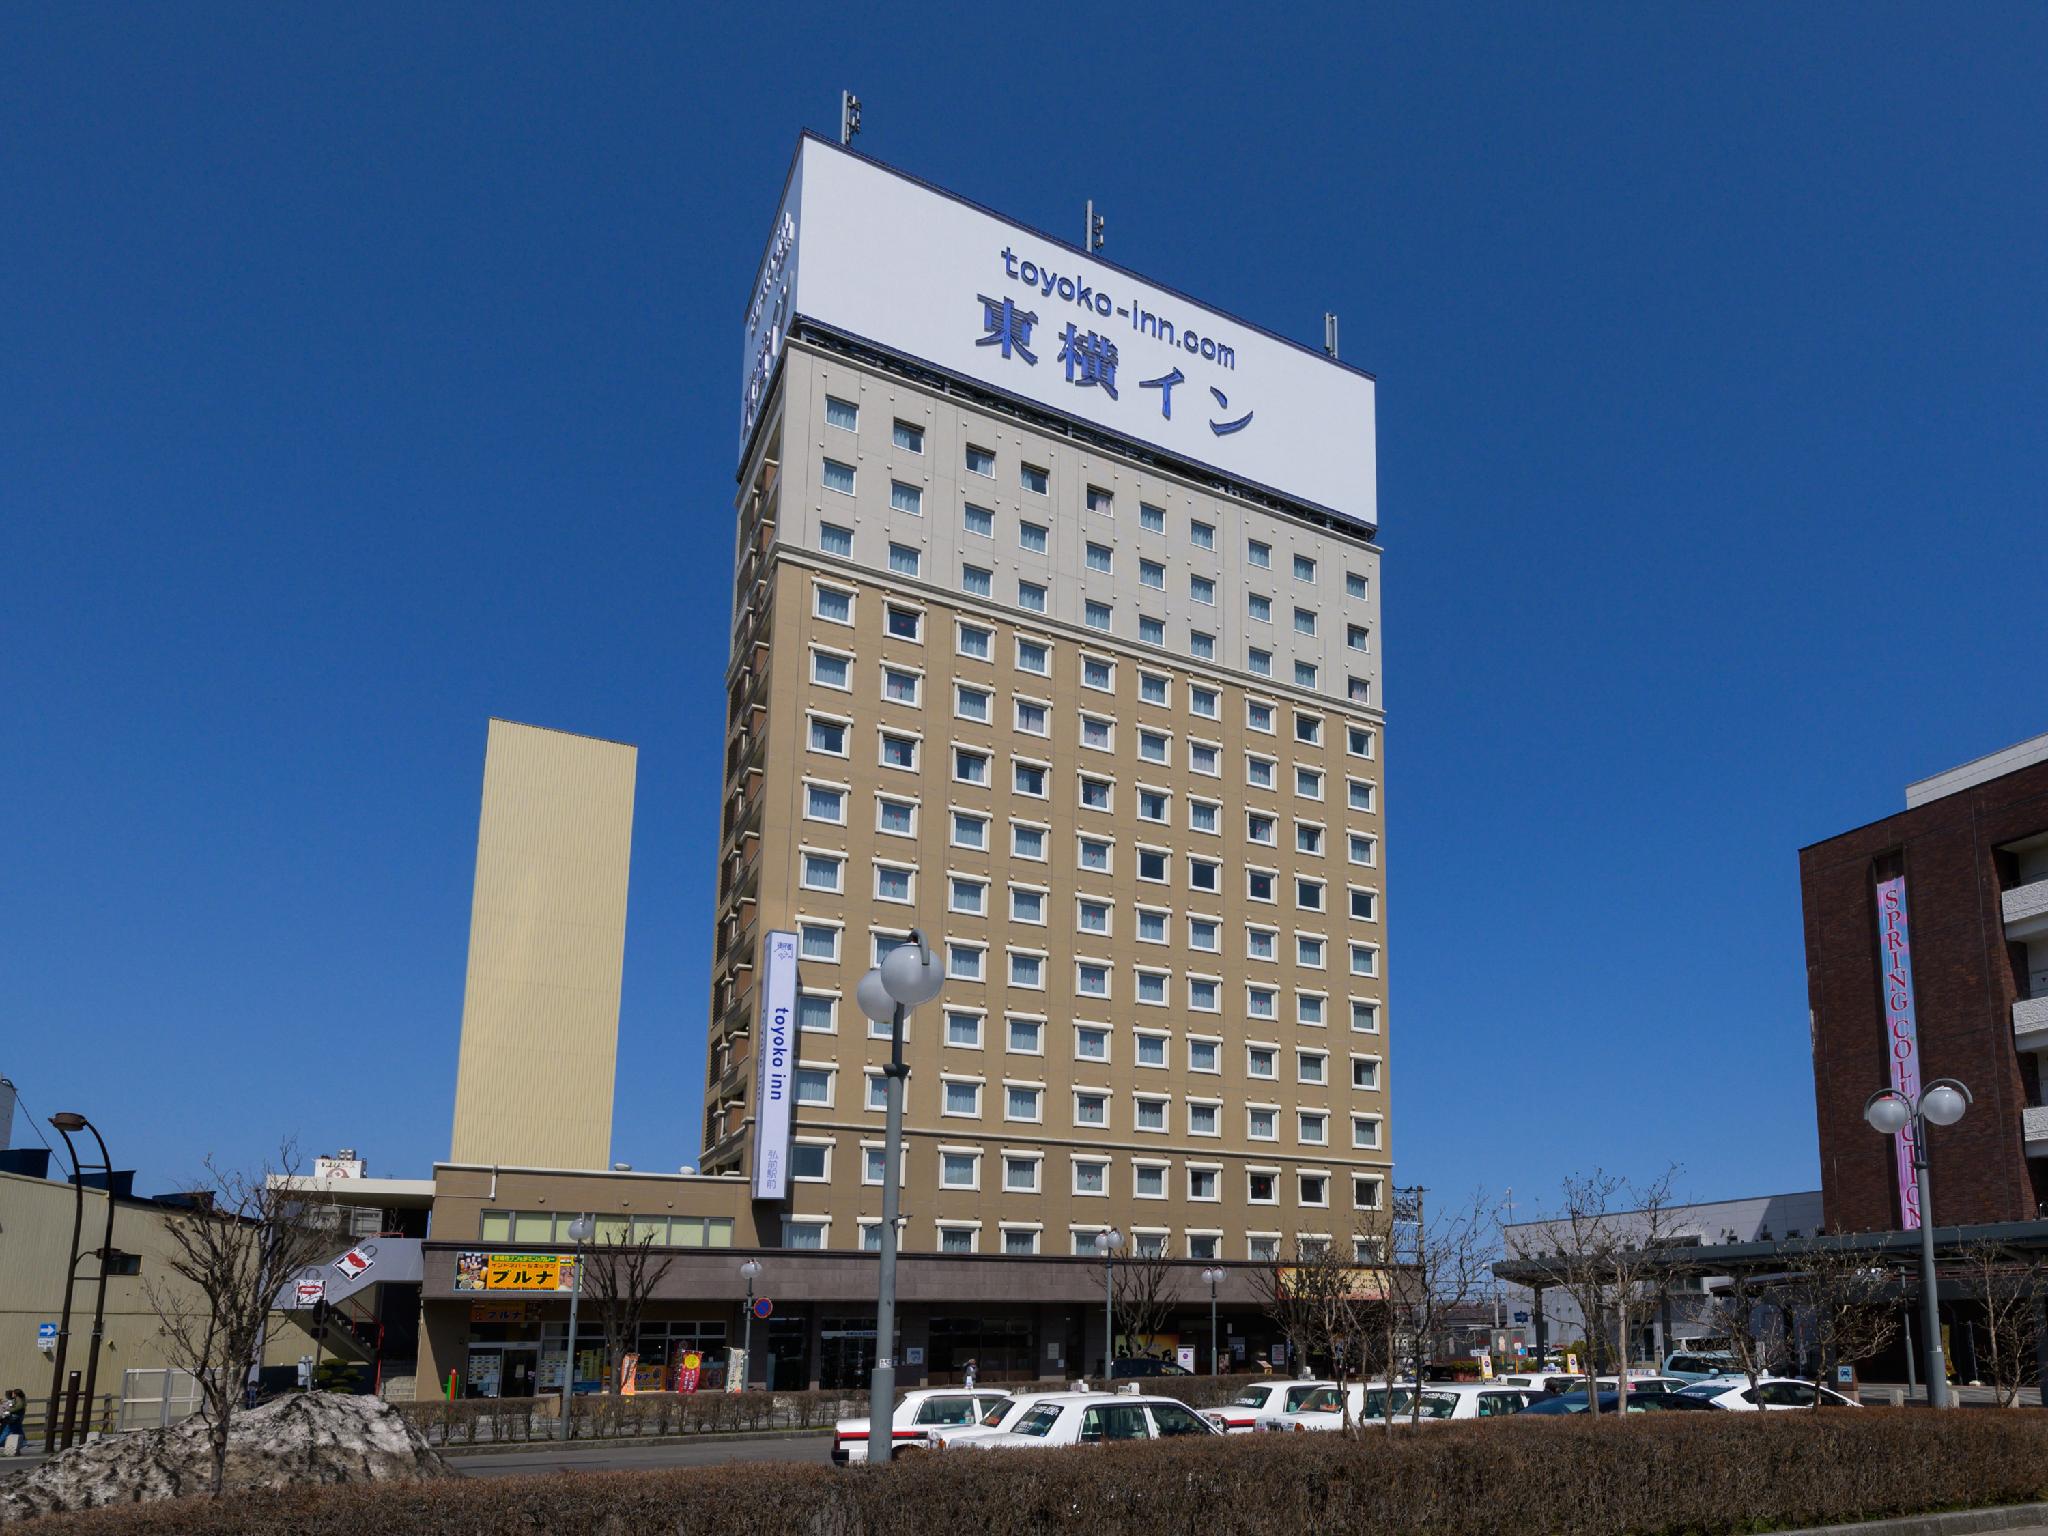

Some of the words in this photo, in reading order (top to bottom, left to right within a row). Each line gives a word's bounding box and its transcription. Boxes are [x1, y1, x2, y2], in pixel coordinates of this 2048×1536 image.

[975, 293, 1254, 437] 東横イン
[1001, 247, 1235, 371] toyoko-inn.com
[1885, 889, 1908, 1013] SPRING
[770, 1007, 789, 1068] toyoko
[770, 1072, 787, 1101] inn
[1893, 1019, 1922, 1227] COLLCTION
